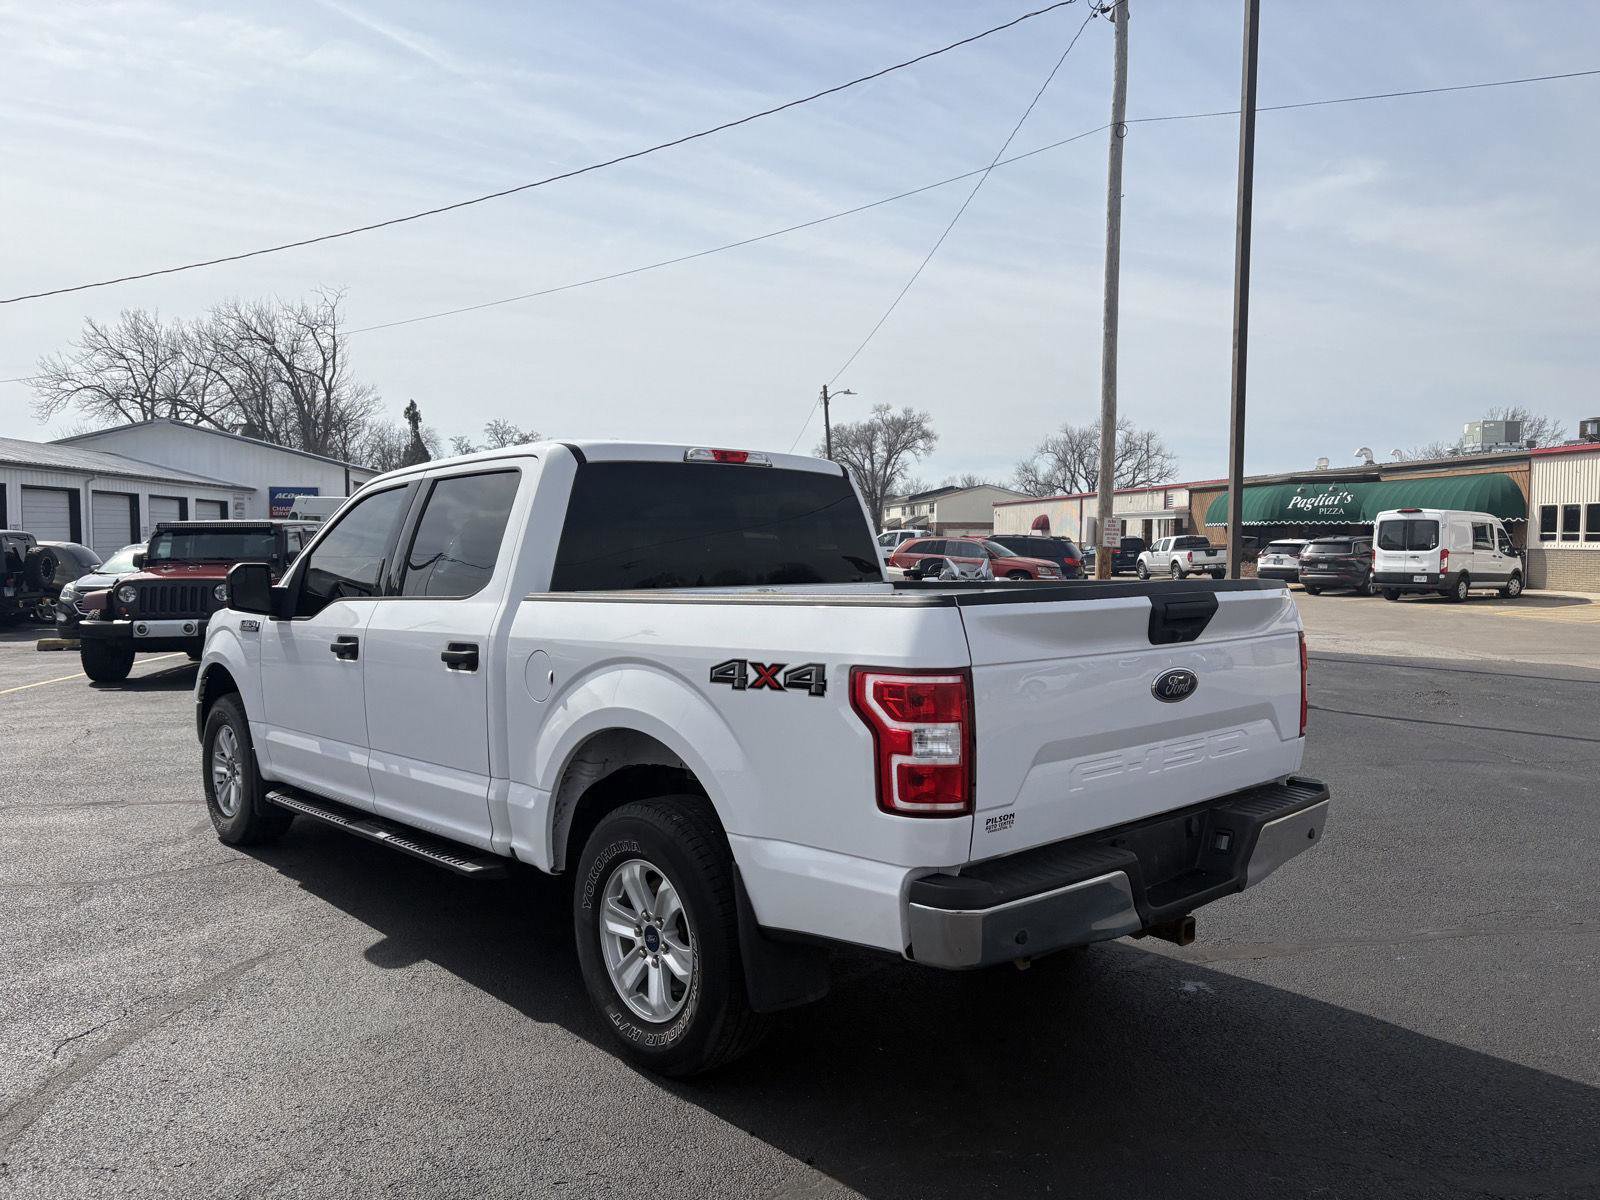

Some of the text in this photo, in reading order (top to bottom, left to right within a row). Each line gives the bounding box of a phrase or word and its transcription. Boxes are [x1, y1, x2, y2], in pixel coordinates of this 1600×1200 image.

[1286, 491, 1354, 511] Pagliai's
[1318, 507, 1345, 515] PIZZA
[985, 812, 1016, 826] PILSON
[582, 840, 642, 909] YOKOHAMA
